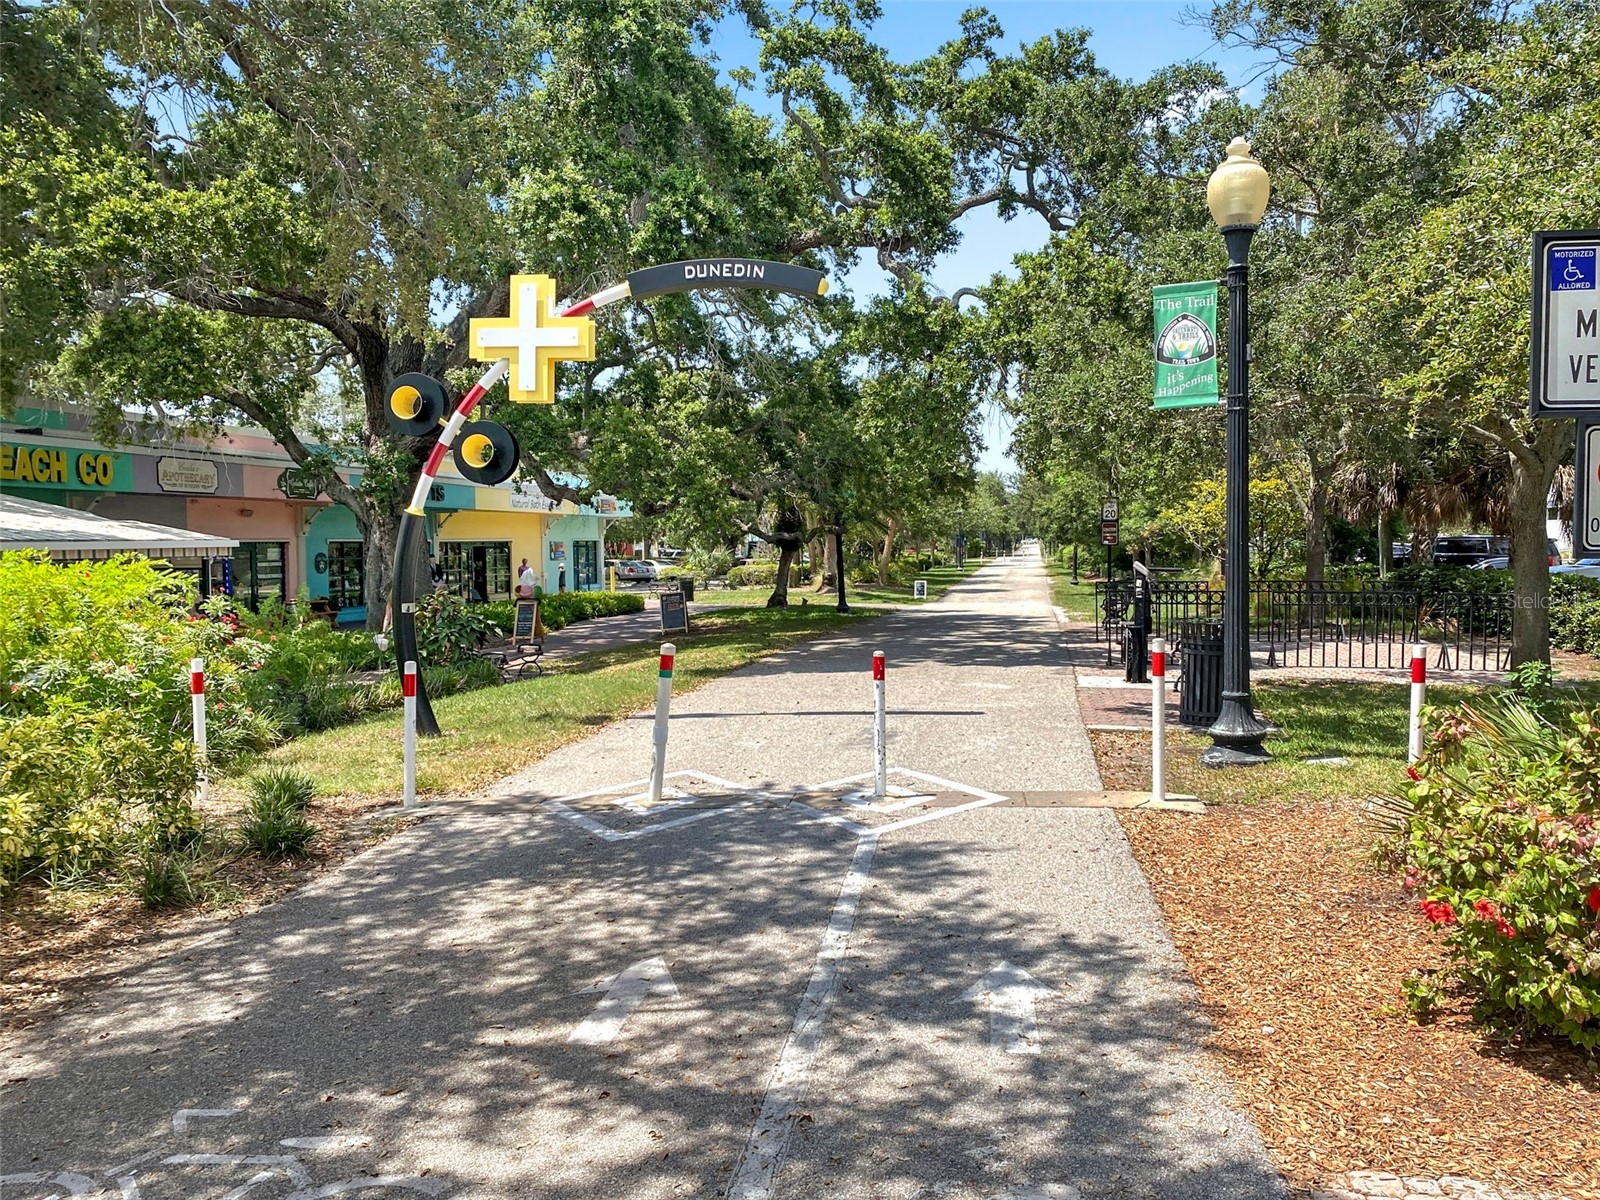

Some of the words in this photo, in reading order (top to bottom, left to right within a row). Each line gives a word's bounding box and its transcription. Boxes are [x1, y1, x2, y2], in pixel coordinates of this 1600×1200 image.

[1554, 250, 1595, 259] MOTORIZED
[684, 263, 765, 279] DUNEDIN
[1557, 281, 1591, 290] ALLOWED
[1157, 298, 1182, 311] The
[1184, 293, 1215, 308] Trail
[1576, 309, 1598, 338] M
[1569, 354, 1599, 384] VE
[1158, 373, 1214, 397] Happening
[0, 444, 68, 483] EACH
[78, 452, 114, 486] CO
[511, 498, 530, 509] Natural
[1104, 509, 1116, 519] 20
